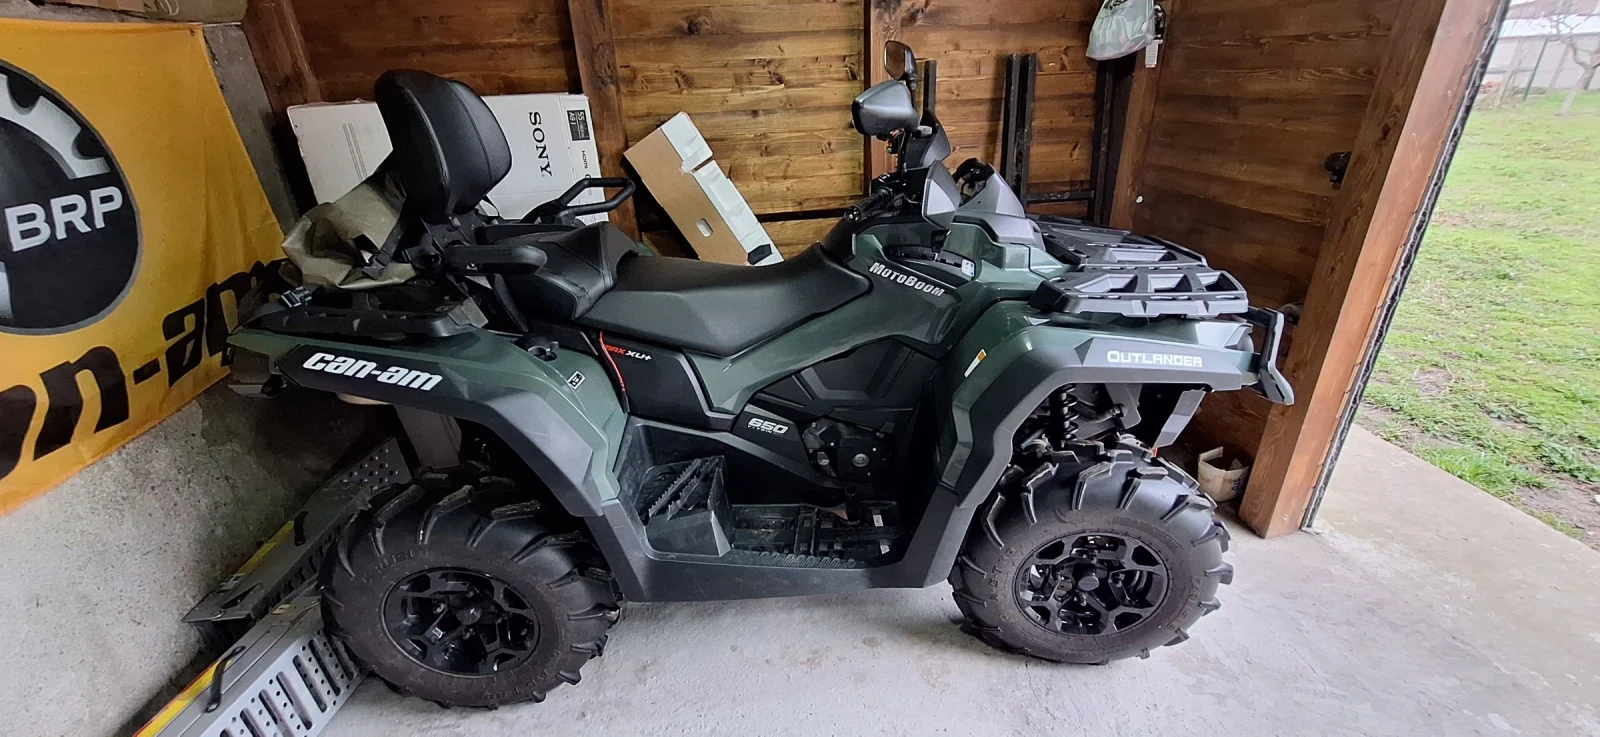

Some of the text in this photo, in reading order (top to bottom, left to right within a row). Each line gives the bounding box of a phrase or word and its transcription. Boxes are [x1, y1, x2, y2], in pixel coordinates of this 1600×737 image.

[528, 111, 554, 178] SONY
[3, 186, 124, 253] BRP
[302, 352, 443, 392] can-am
[748, 417, 789, 434] 650
